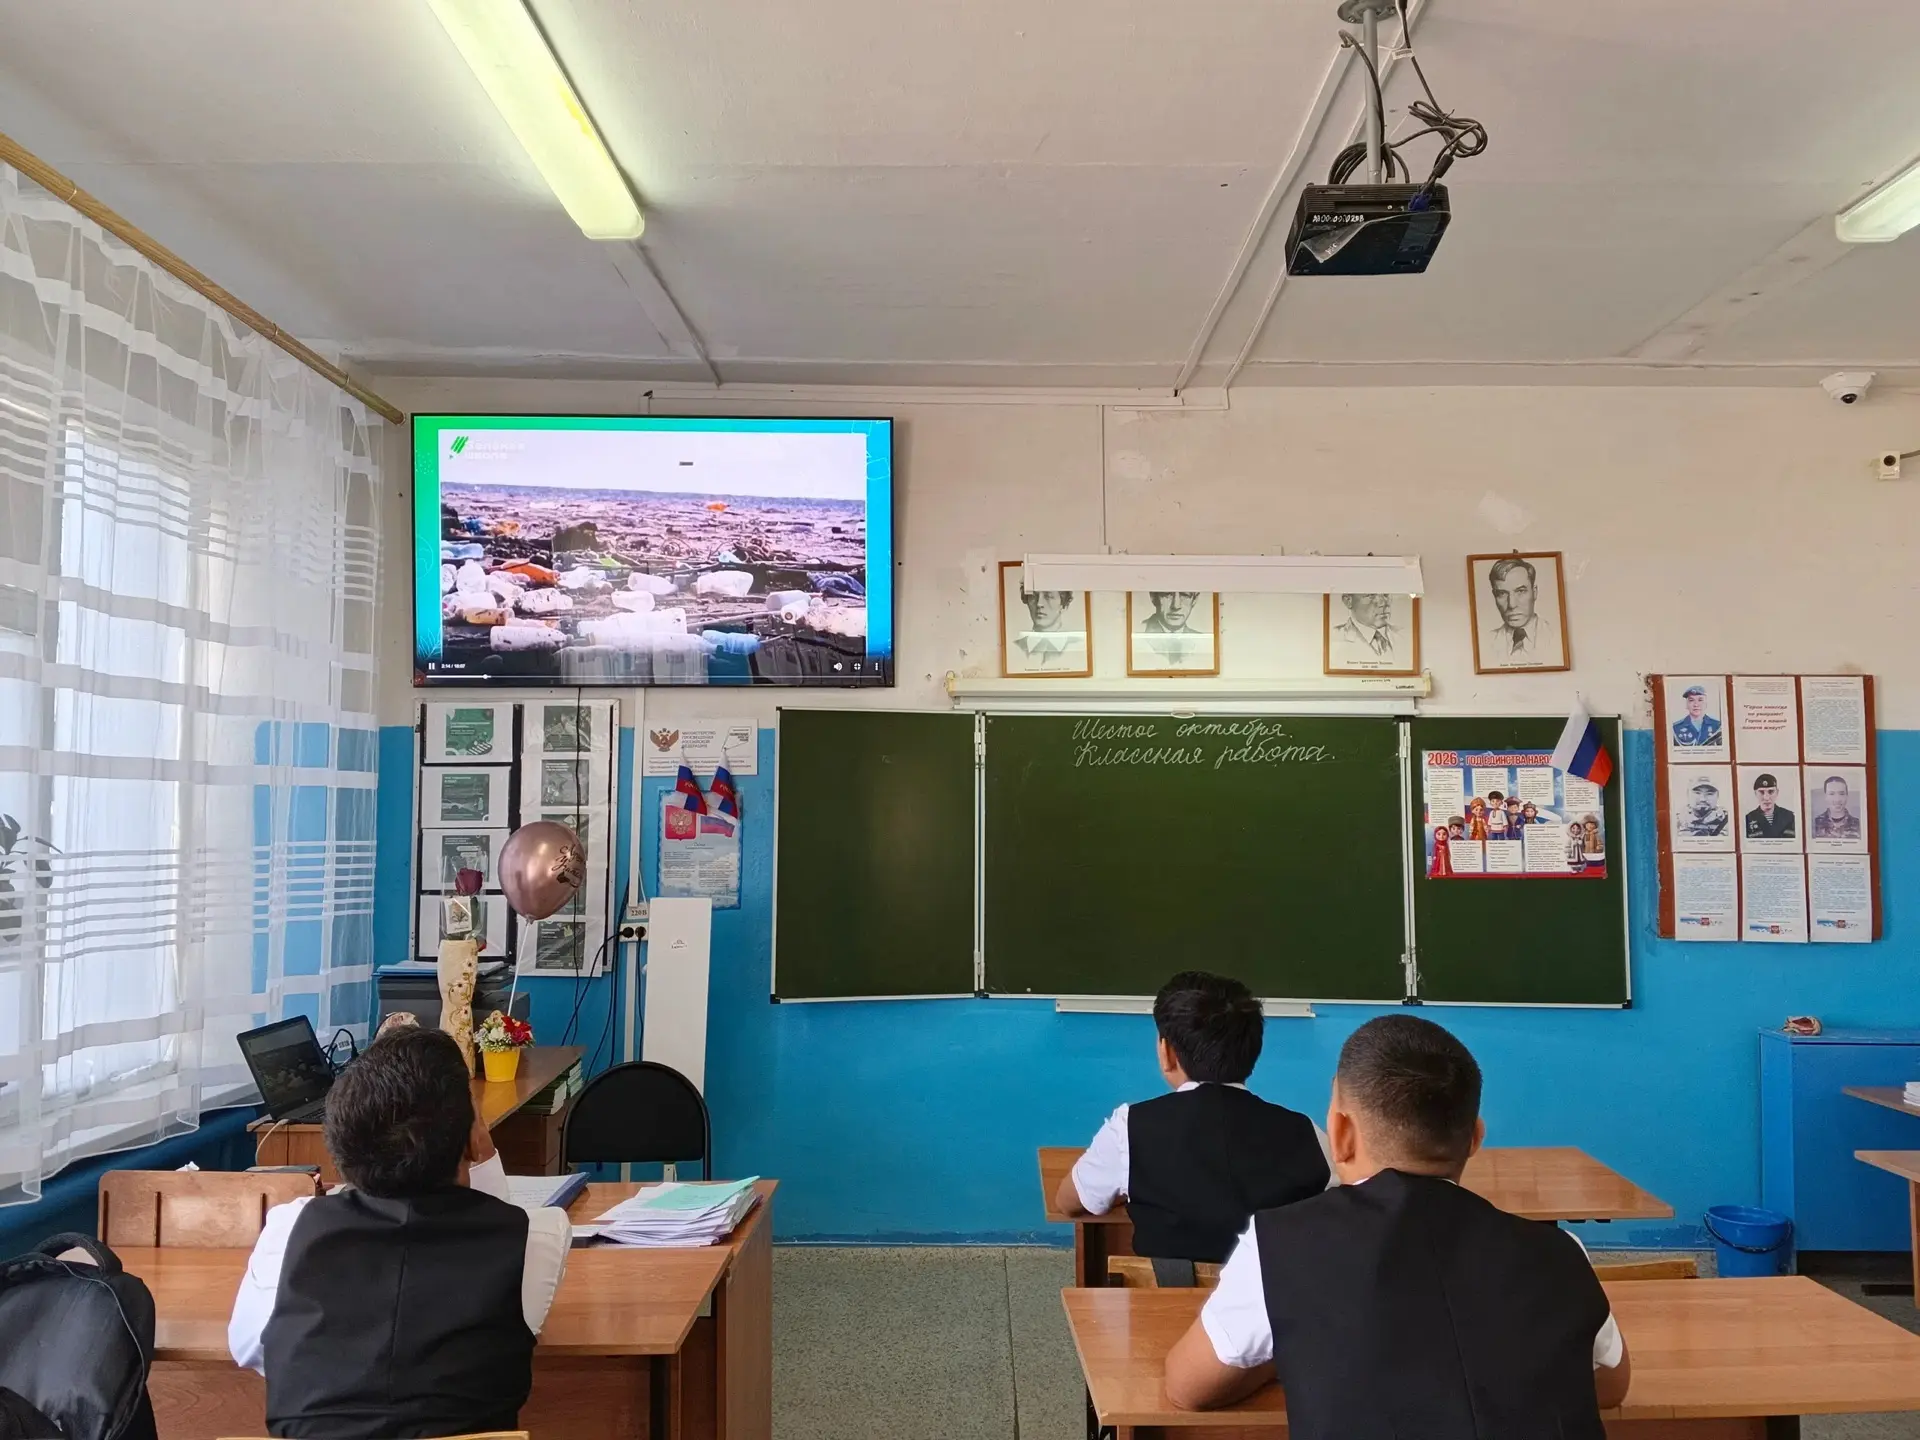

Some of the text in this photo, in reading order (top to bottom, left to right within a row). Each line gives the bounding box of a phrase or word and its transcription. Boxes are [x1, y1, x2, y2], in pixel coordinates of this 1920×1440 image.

[1072, 718, 1158, 740] Шестое
[1073, 741, 1206, 767] Классная
[1427, 752, 1553, 766] 2026 ГОД ЕДИНСТВА НАРО
